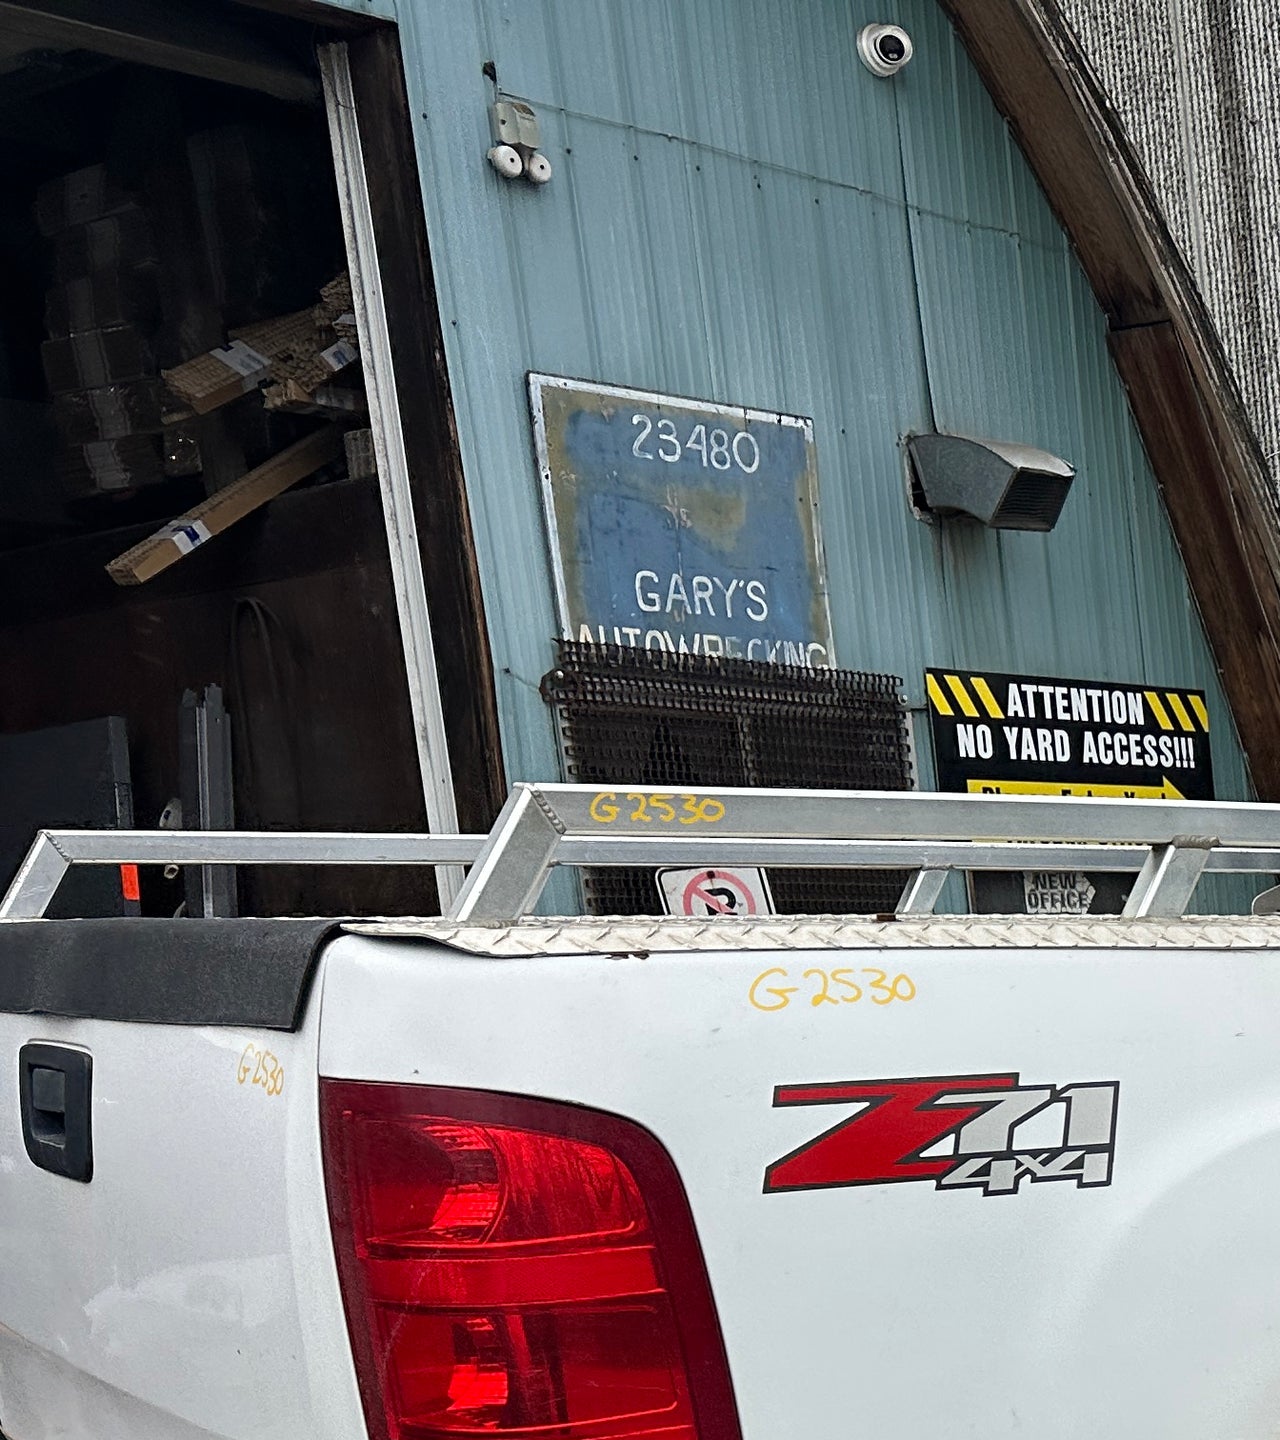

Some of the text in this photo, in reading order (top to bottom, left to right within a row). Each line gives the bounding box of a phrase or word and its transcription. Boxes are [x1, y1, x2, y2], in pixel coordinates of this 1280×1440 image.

[631, 413, 761, 474] 23480
[635, 570, 769, 622] GARY'S
[1007, 682, 1145, 726] ATTENTION
[956, 723, 1196, 769] NO YARD ACCESS!!!
[589, 792, 726, 825] G2530
[1027, 890, 1091, 911] OFFICE
[1033, 872, 1077, 890] NEW
[748, 967, 917, 1011] G2530
[762, 1072, 1121, 1194] Z71
